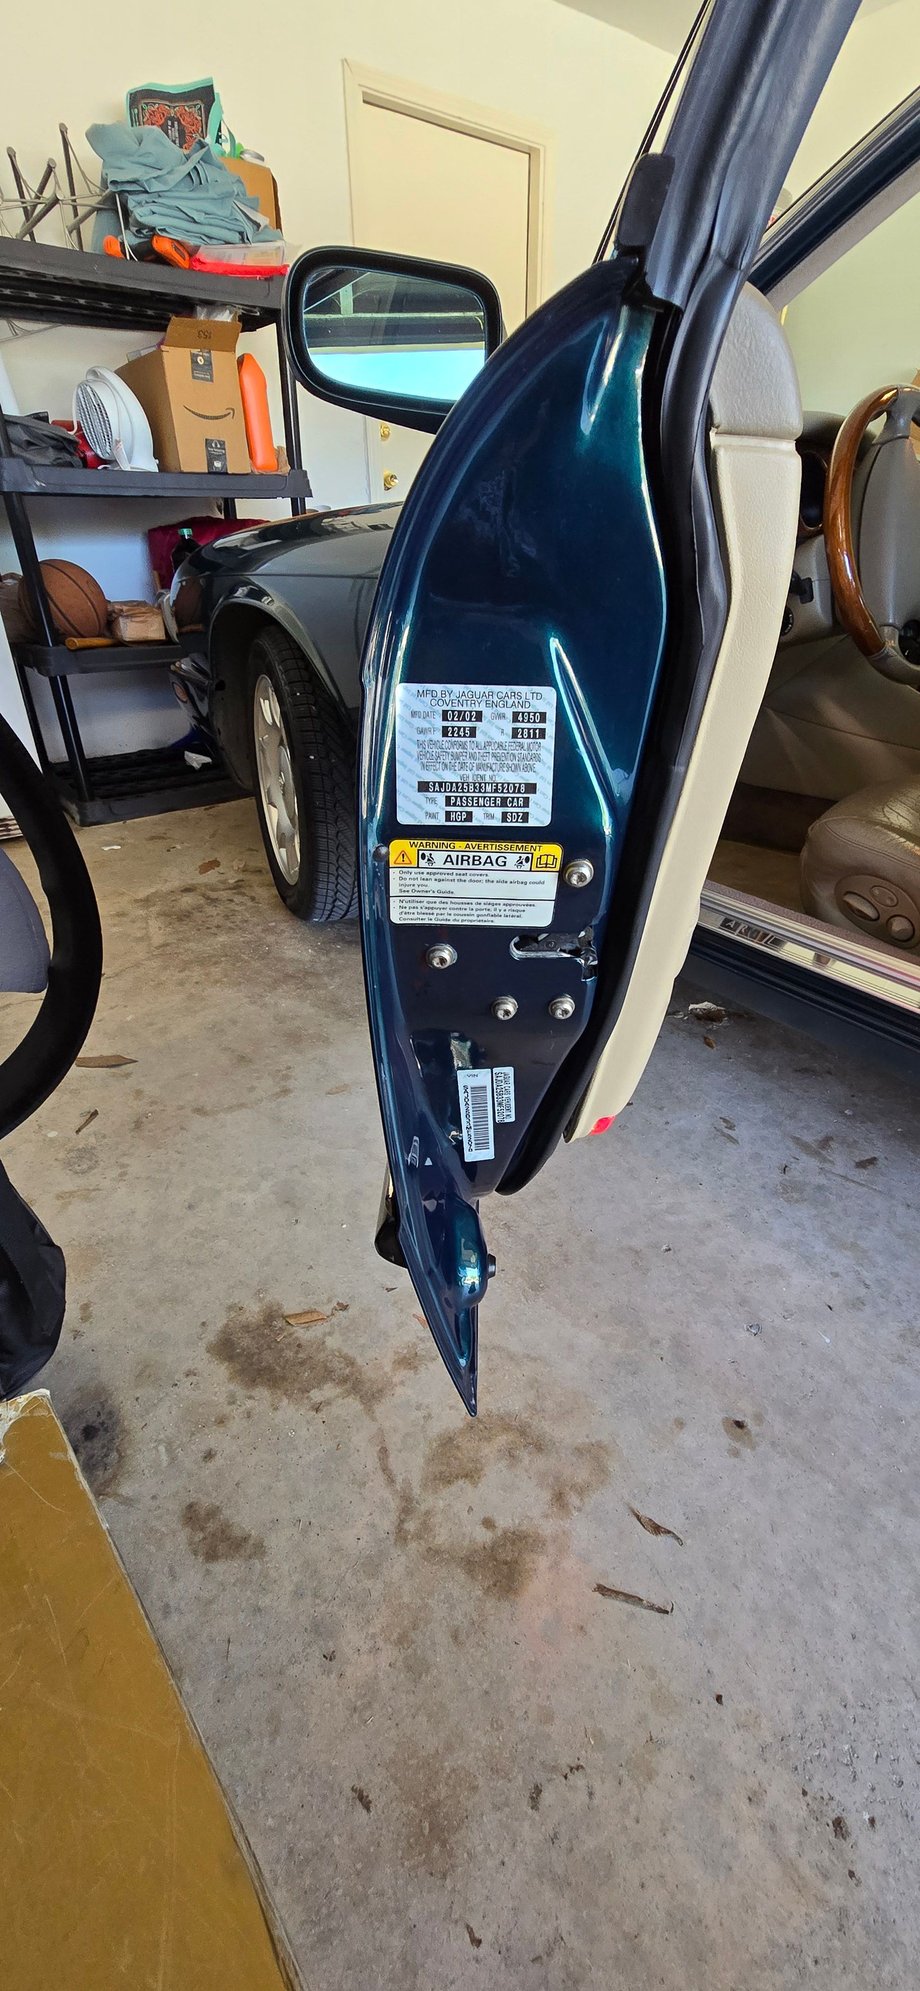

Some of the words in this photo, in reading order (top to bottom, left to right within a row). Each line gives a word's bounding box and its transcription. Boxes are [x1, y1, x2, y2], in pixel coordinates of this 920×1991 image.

[416, 690, 438, 698] MFD
[440, 690, 454, 698] BY
[456, 690, 494, 699] JAGUAR
[496, 691, 522, 700] CARS
[525, 692, 543, 700] LTD
[430, 699, 483, 708] COVENTRY
[485, 700, 531, 709] ENGLAND
[424, 711, 436, 719] DATE
[447, 710, 476, 721] 02/02
[518, 712, 540, 722] 4950
[447, 727, 470, 737] 2245
[518, 728, 540, 738] 2811
[429, 782, 526, 792] SAJDA25B33MF52078
[450, 797, 500, 807] PASSENGER
[507, 798, 524, 807] CAR
[450, 812, 467, 821] HGP
[507, 812, 523, 822] SDZ
[409, 841, 456, 850] WARNING
[464, 843, 542, 852] AVERTISSEMENT
[443, 854, 507, 867] AIRBAG
